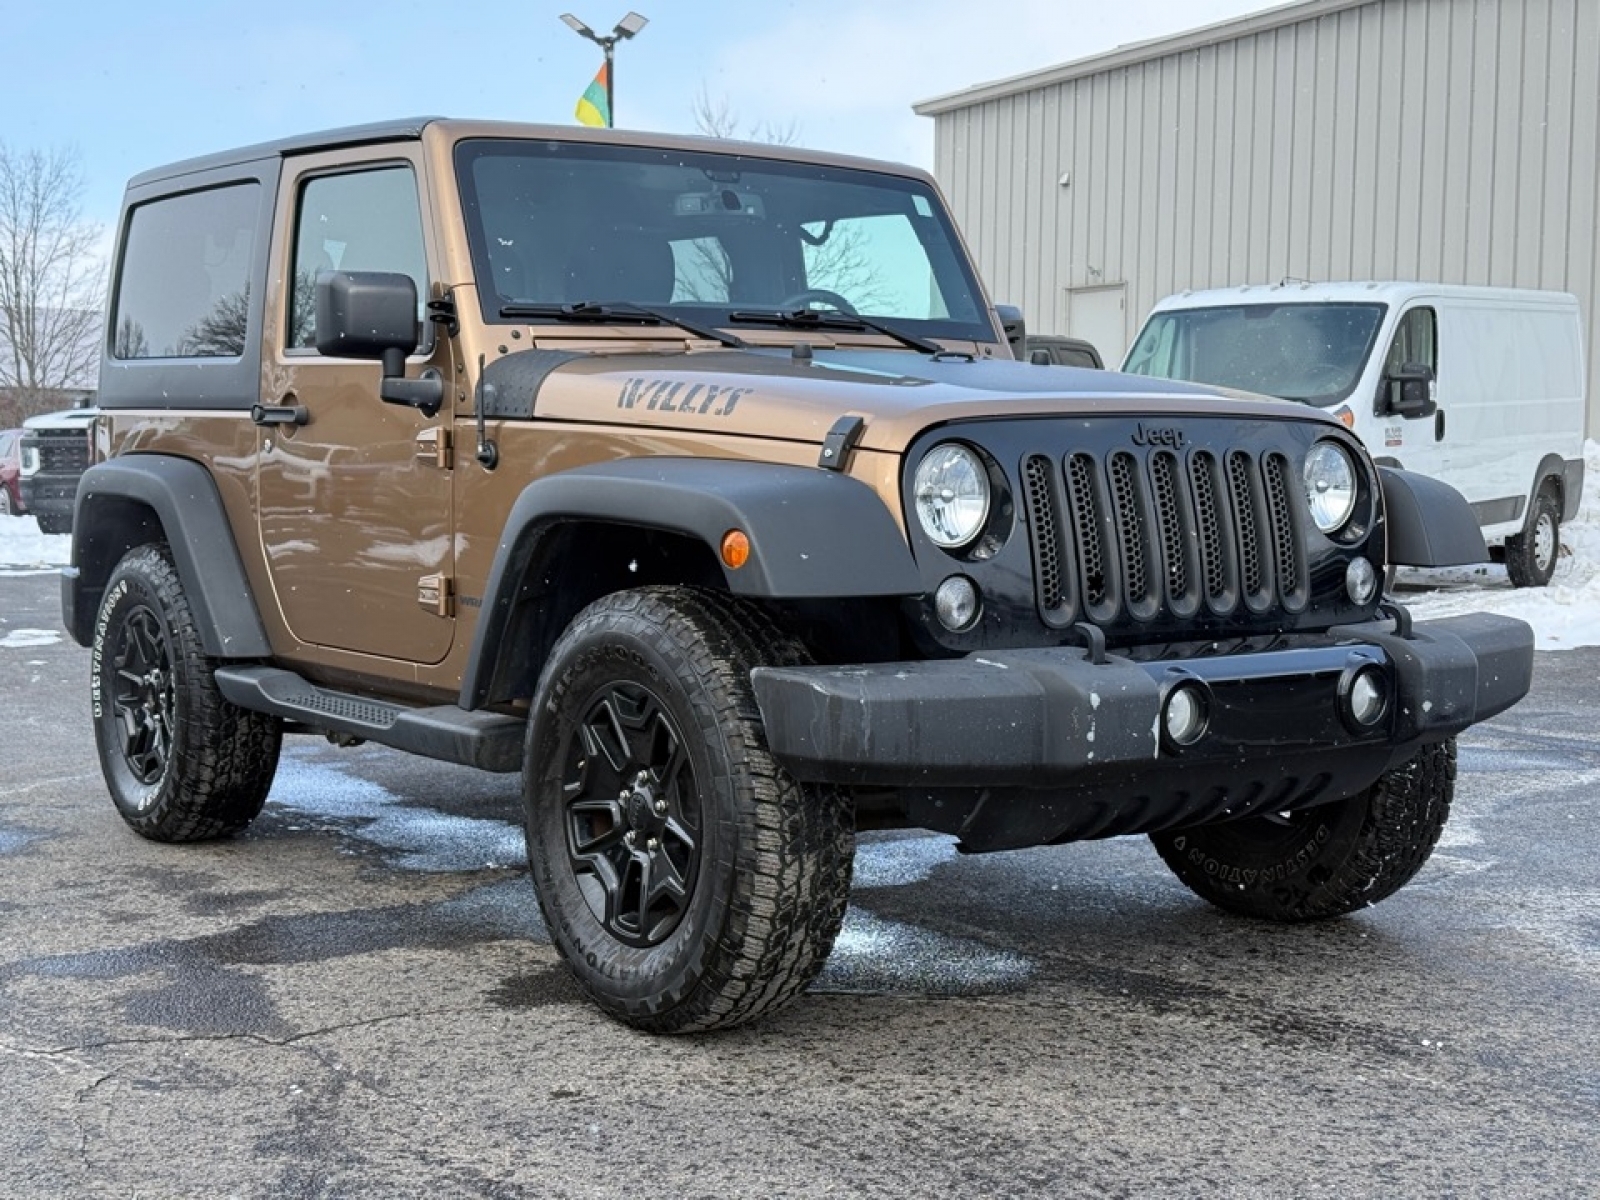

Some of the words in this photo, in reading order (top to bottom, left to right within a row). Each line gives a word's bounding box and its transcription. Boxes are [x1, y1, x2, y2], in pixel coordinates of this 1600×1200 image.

[617, 377, 755, 416] WILLYS
[1131, 422, 1186, 451] Jeep
[1187, 823, 1331, 884] DESTINATION
